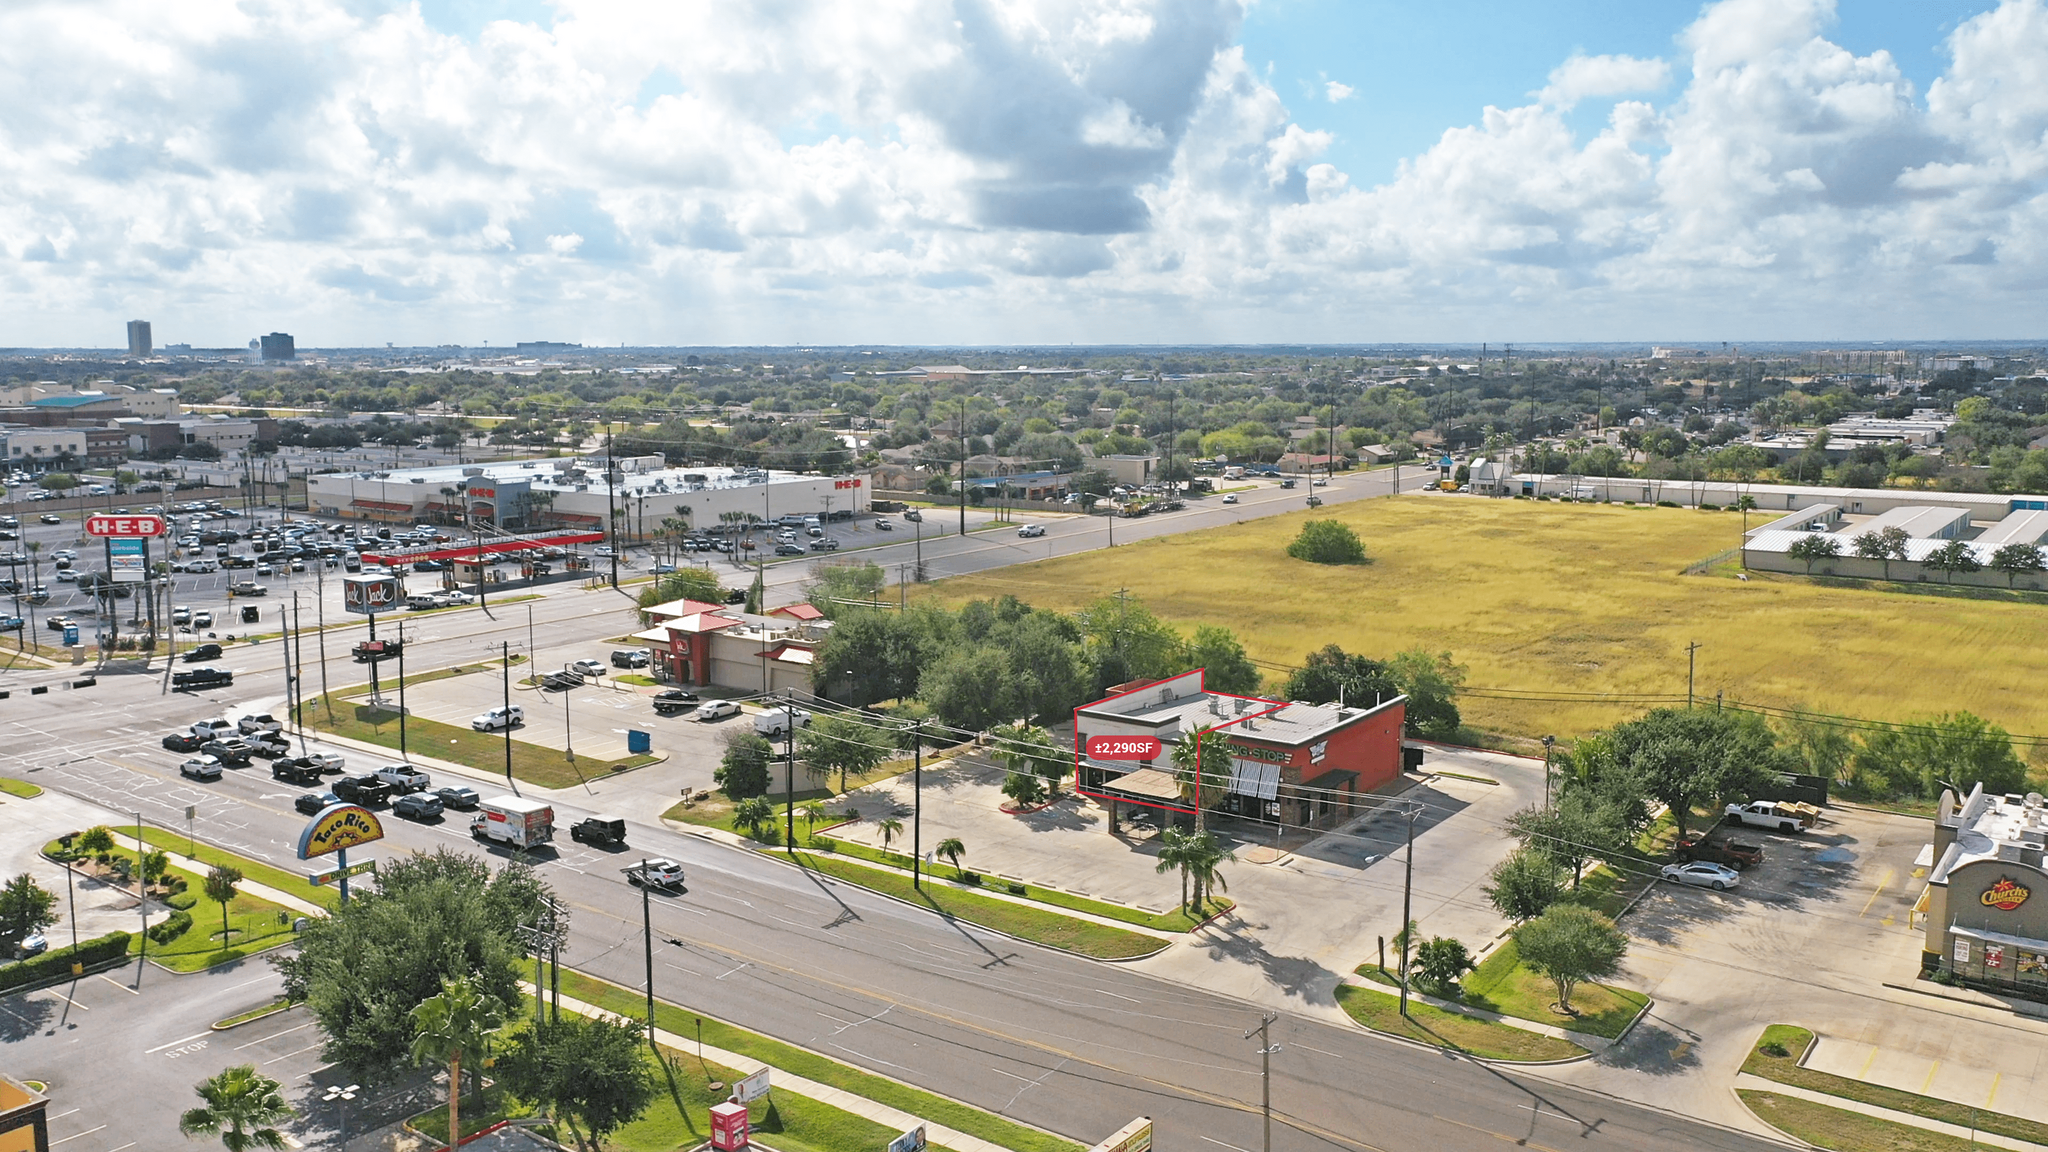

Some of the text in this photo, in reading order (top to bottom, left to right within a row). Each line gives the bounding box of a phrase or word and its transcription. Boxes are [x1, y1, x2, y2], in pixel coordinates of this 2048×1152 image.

[92, 520, 155, 533] H-E-B
[346, 584, 363, 604] Jack
[367, 583, 394, 604] Jack
[314, 813, 370, 844] Taco Rico
[330, 862, 375, 880] DRIVE THRU
[1981, 887, 2028, 905] Church's
[165, 1040, 209, 1059] STOP
